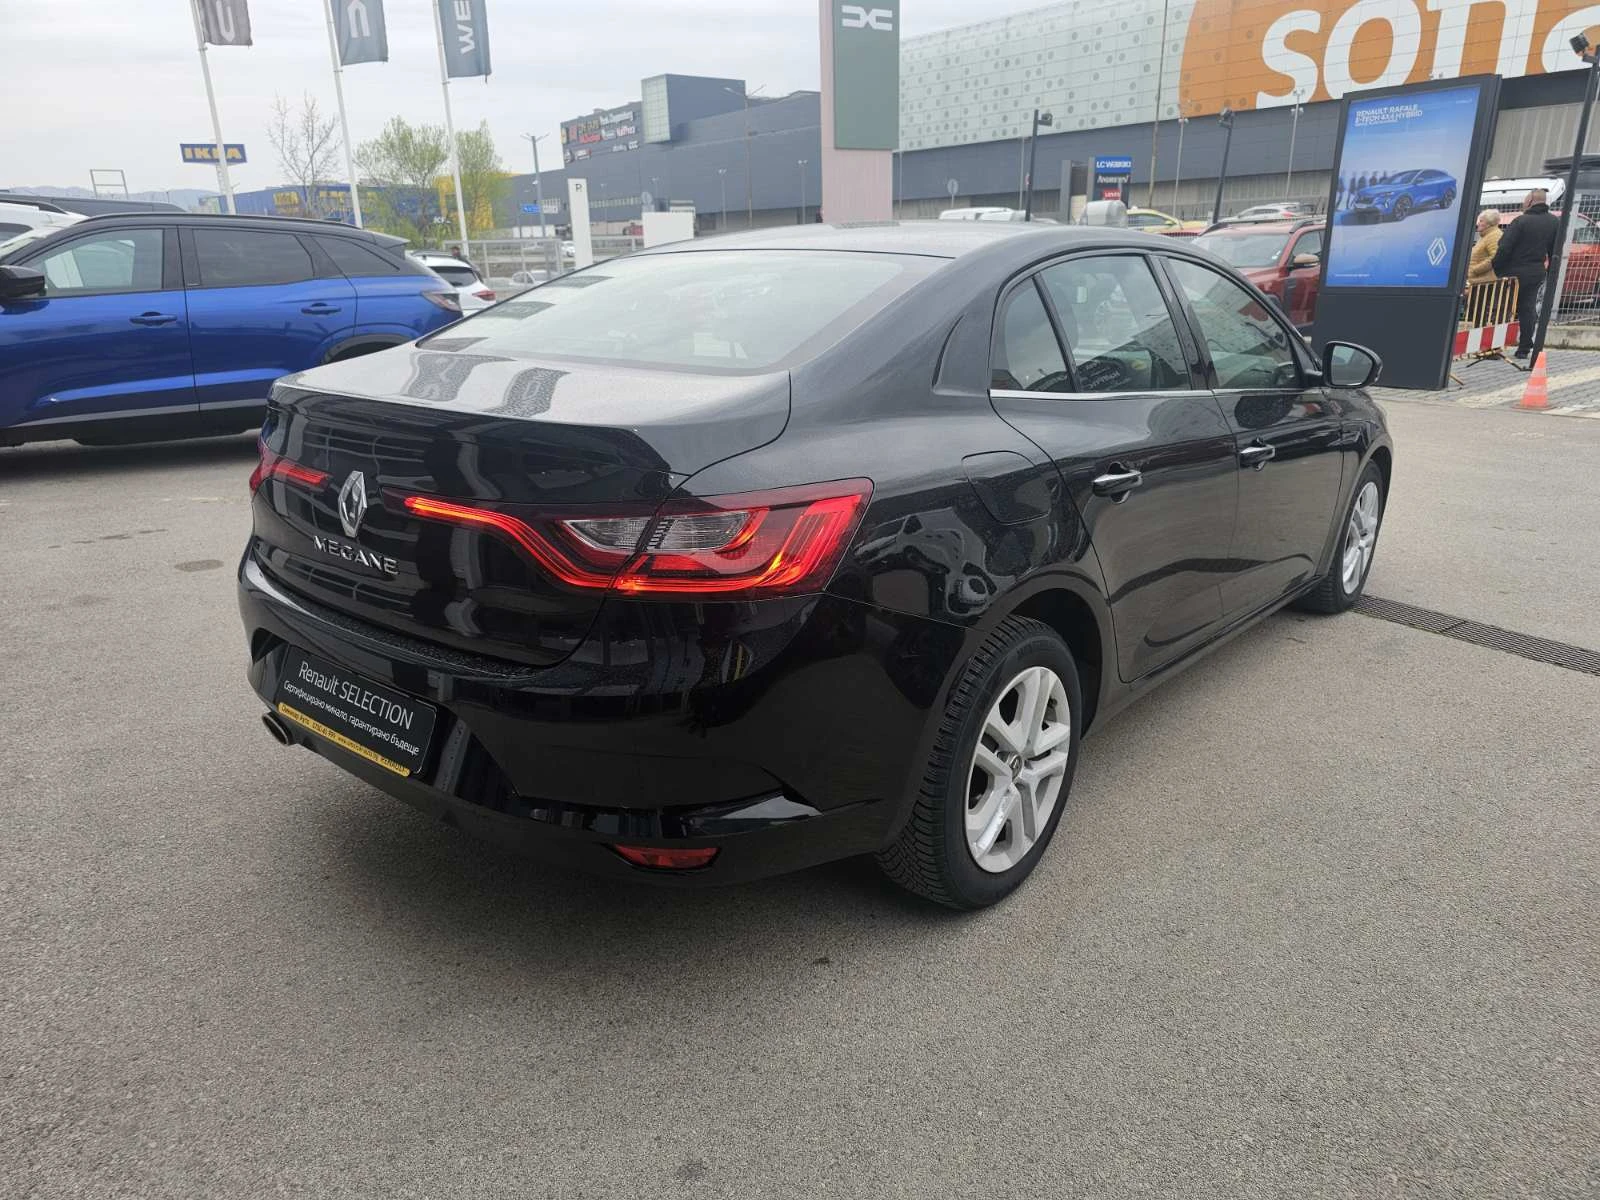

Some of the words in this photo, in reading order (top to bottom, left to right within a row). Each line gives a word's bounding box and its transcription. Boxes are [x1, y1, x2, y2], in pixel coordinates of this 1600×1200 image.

[313, 535, 400, 576] MEGANE
[298, 660, 340, 696] Renault
[338, 680, 415, 731] SELECTION
[390, 732, 420, 757] бъдеще
